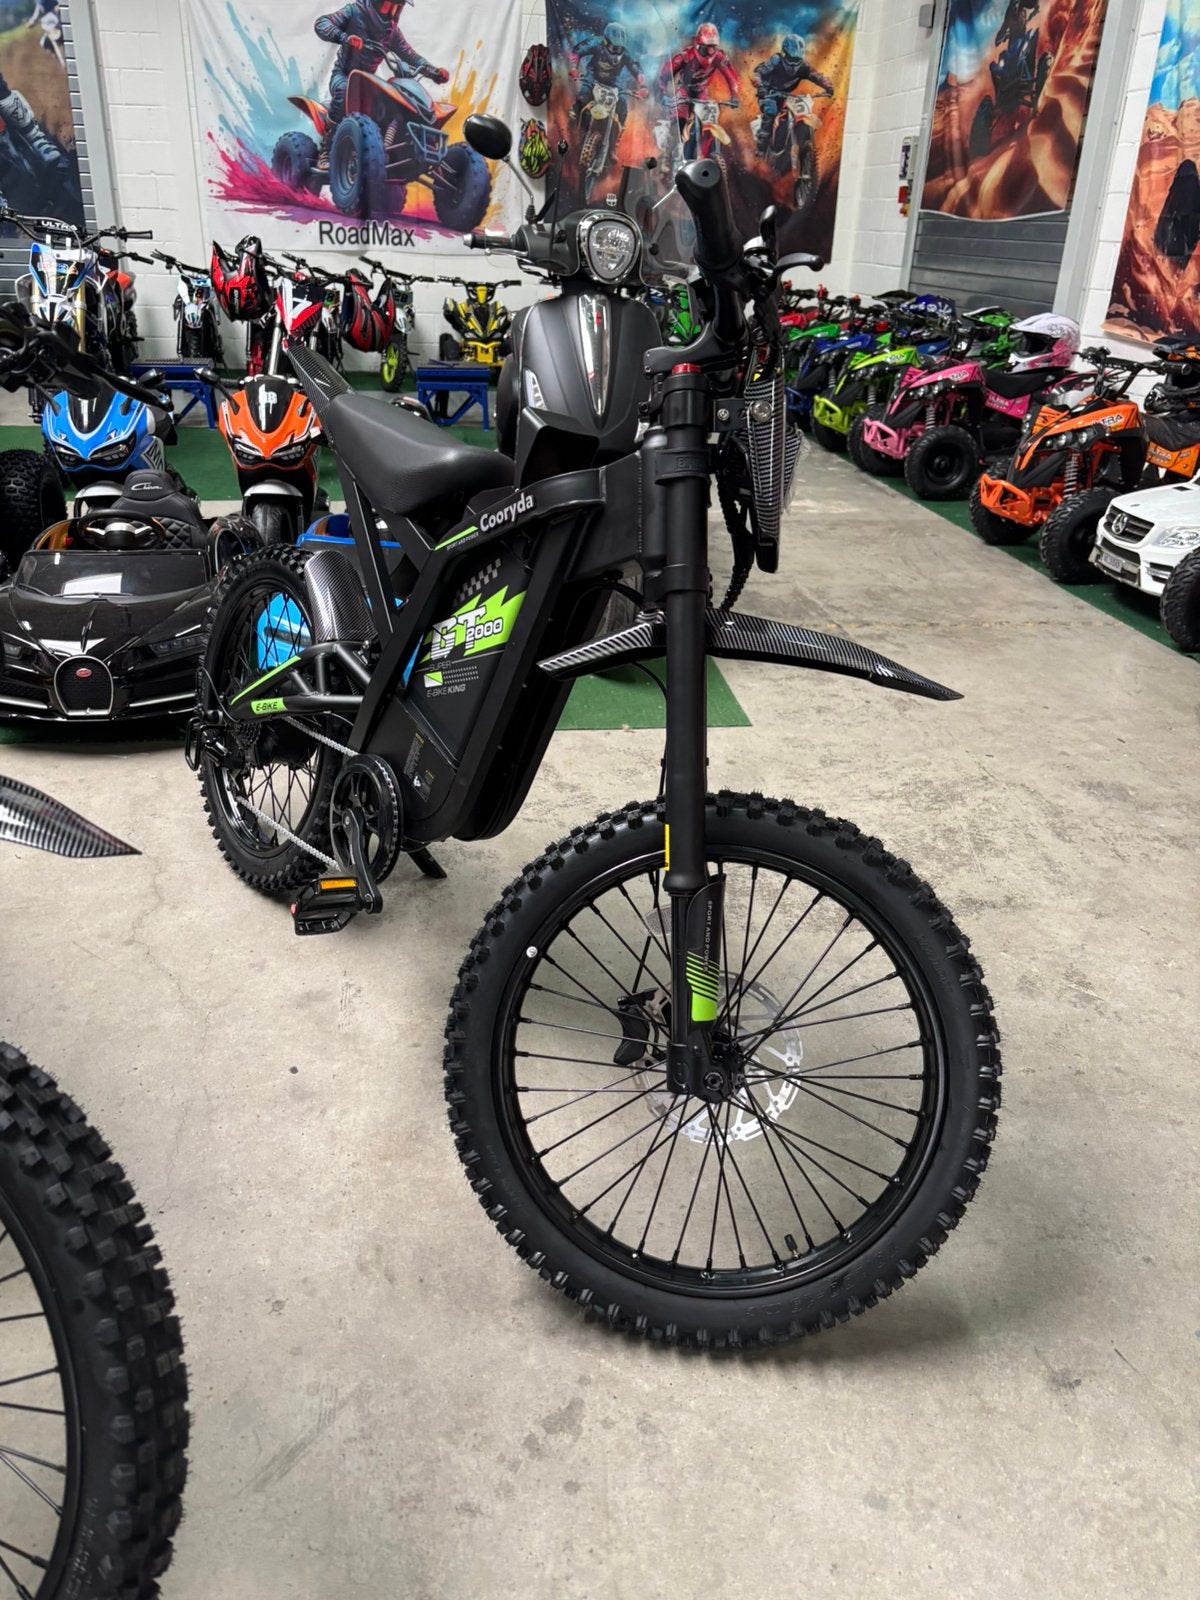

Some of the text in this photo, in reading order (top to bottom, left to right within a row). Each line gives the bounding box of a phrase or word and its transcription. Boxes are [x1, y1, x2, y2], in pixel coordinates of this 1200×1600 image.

[41, 220, 78, 231] ULTRA
[318, 220, 415, 247] RoadMax
[480, 492, 534, 532] Cooryda
[430, 605, 503, 660] GT 2000
[429, 660, 451, 671] SUPER
[426, 683, 466, 698] E-BIKE KING
[255, 701, 278, 711] E-BIKE
[704, 926, 712, 942] AND
